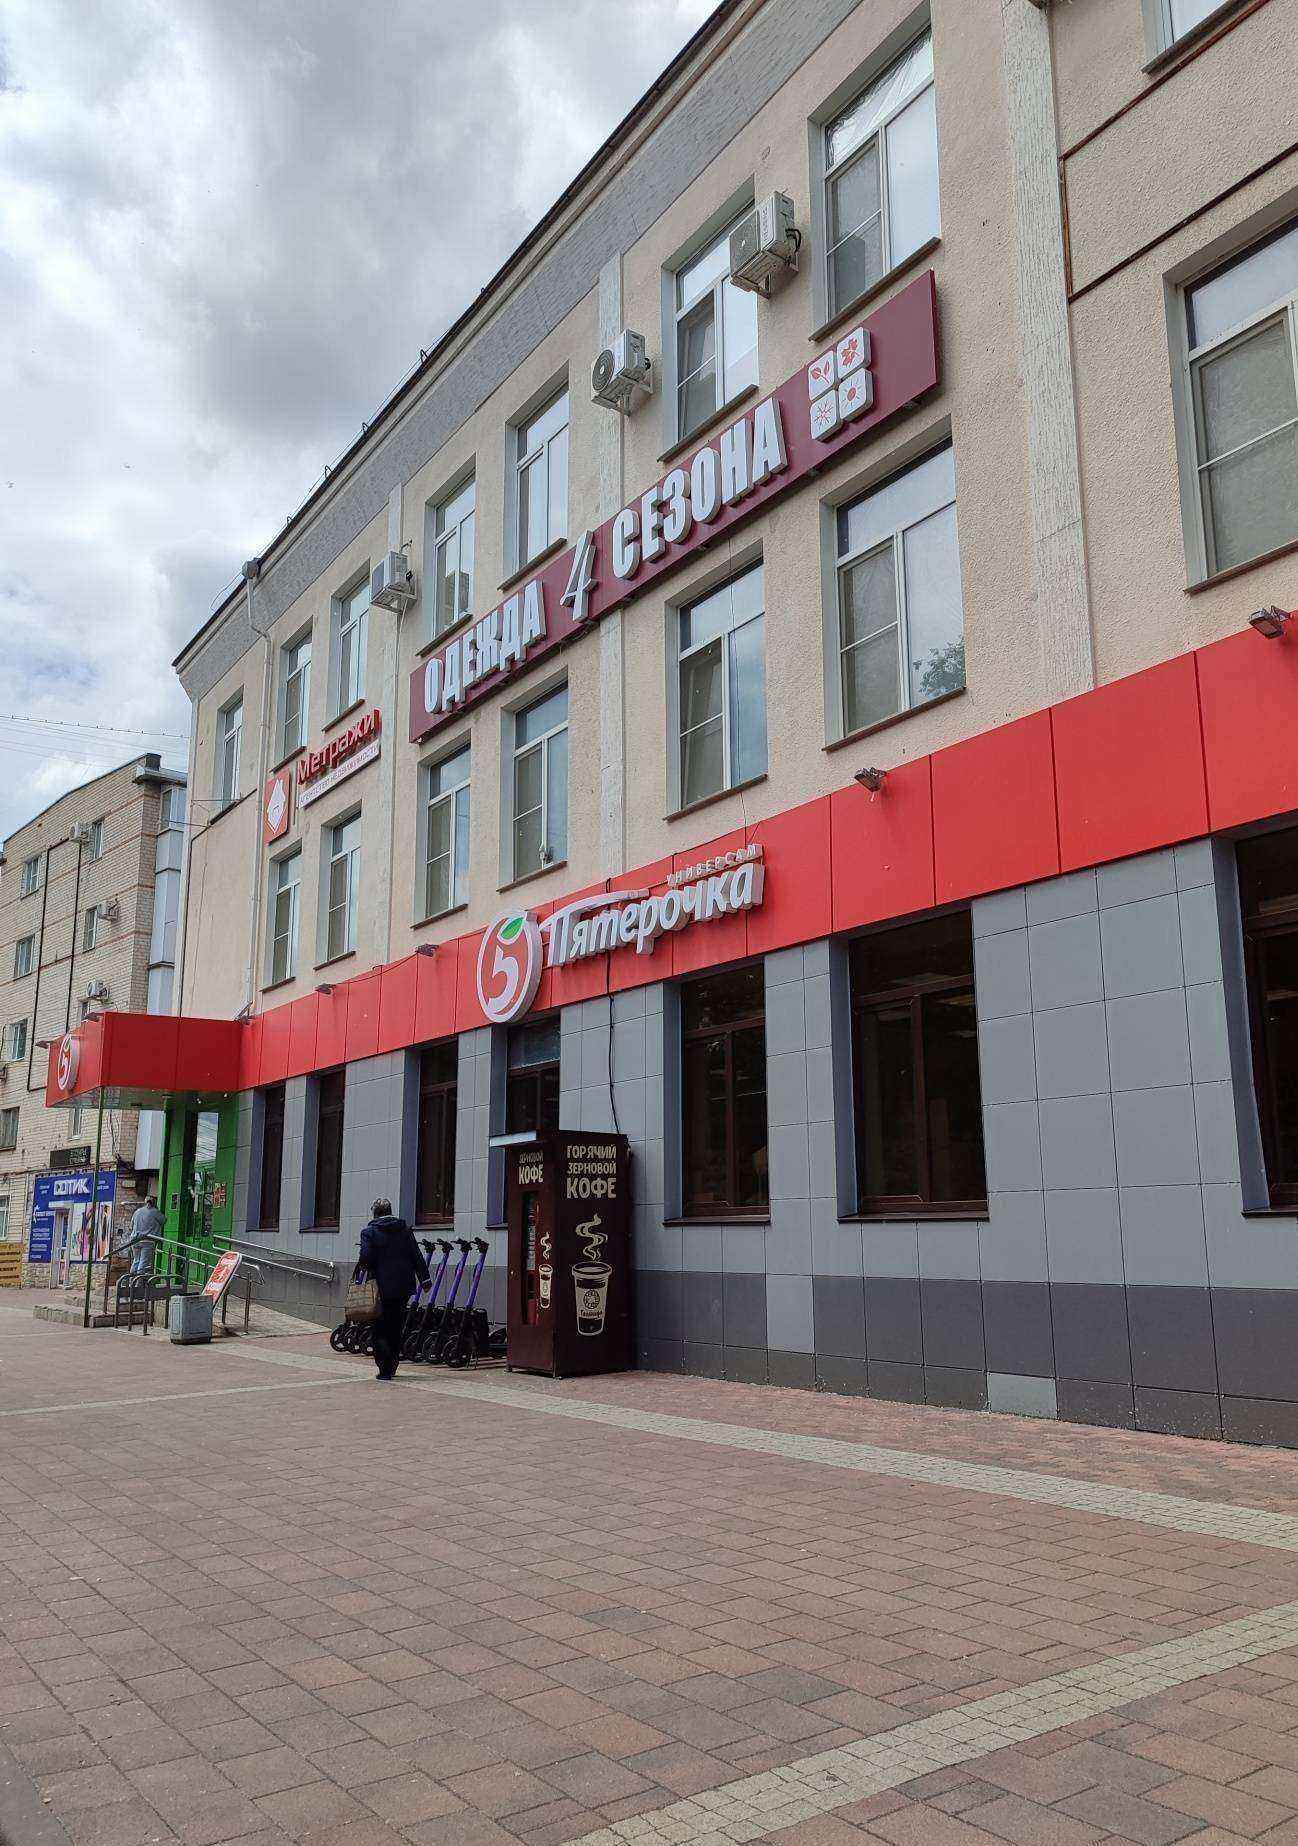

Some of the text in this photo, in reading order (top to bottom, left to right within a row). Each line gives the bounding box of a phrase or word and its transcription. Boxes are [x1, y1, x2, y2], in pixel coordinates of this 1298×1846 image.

[424, 398, 788, 713] ОДЕЖДА 4 СЕЗОНА
[666, 844, 762, 887] УНИВЕРСАМ
[538, 864, 765, 966] Пятерочка
[566, 1145, 617, 1159] ГОРЯЧИЙ
[518, 1164, 544, 1185] КОФЕ
[566, 1161, 617, 1175] ЗЕРНОВОЙ
[566, 1177, 617, 1199] КОФЕ
